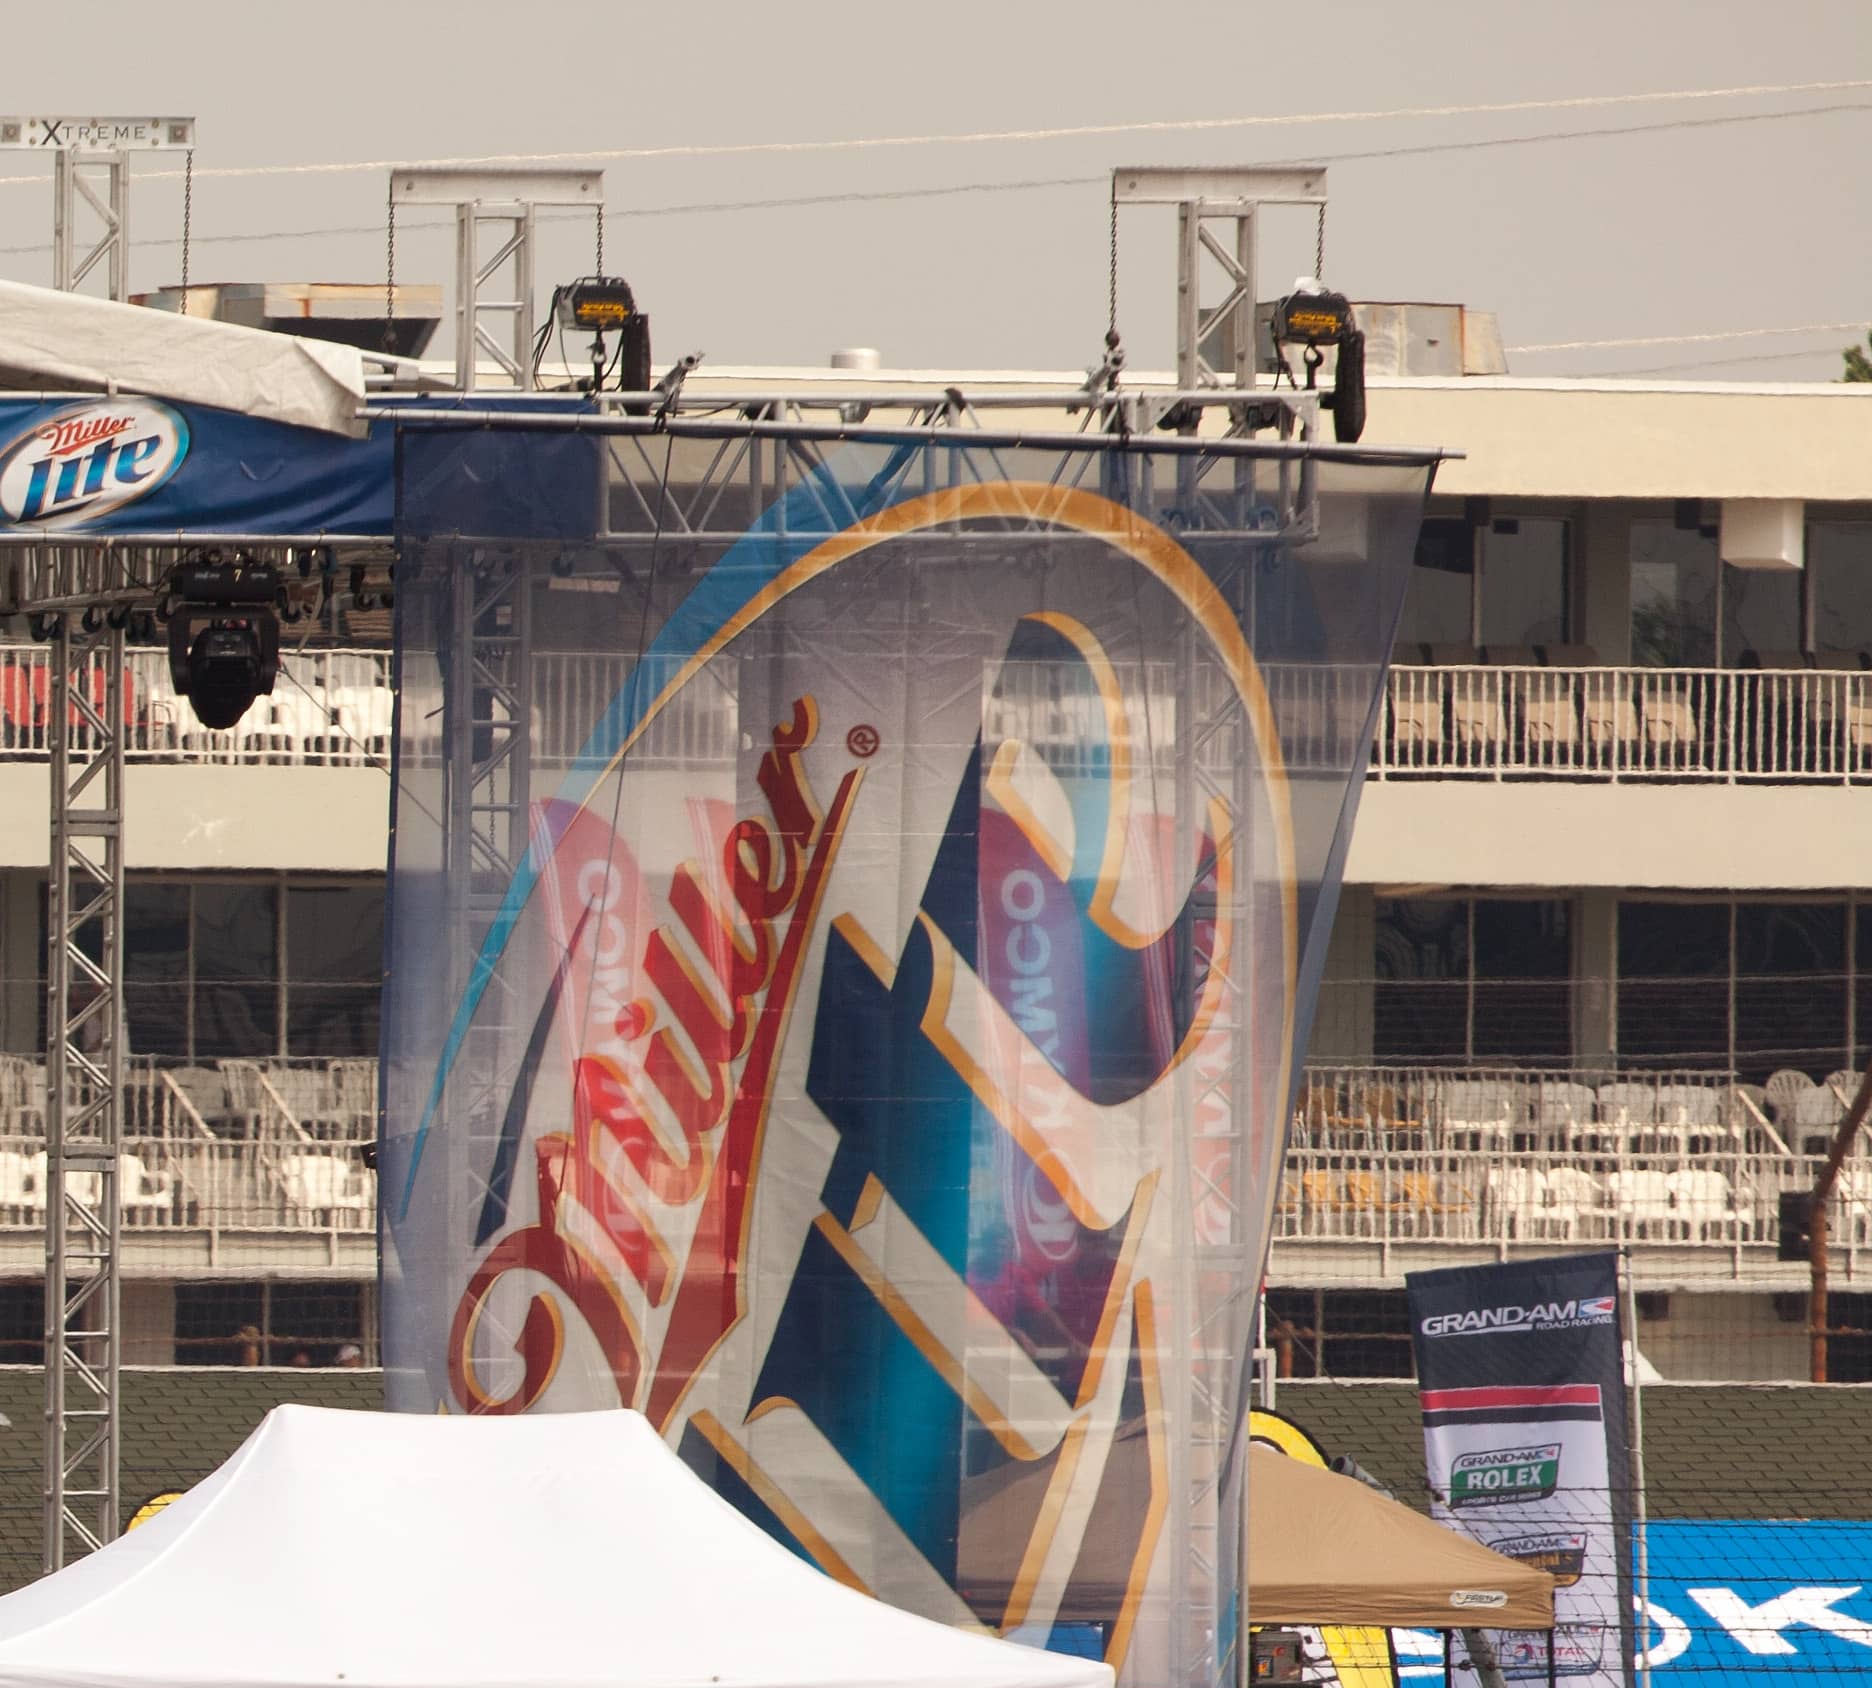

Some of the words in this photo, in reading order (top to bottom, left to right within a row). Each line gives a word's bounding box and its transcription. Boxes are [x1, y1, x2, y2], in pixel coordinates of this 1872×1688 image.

[40, 120, 146, 146] XTREME
[37, 416, 136, 457] Miller
[14, 434, 163, 524] Lite
[1536, 1320, 1571, 1331] ROAD
[1571, 1314, 1614, 1327] RACING
[1466, 1464, 1543, 1490] ROLEX
